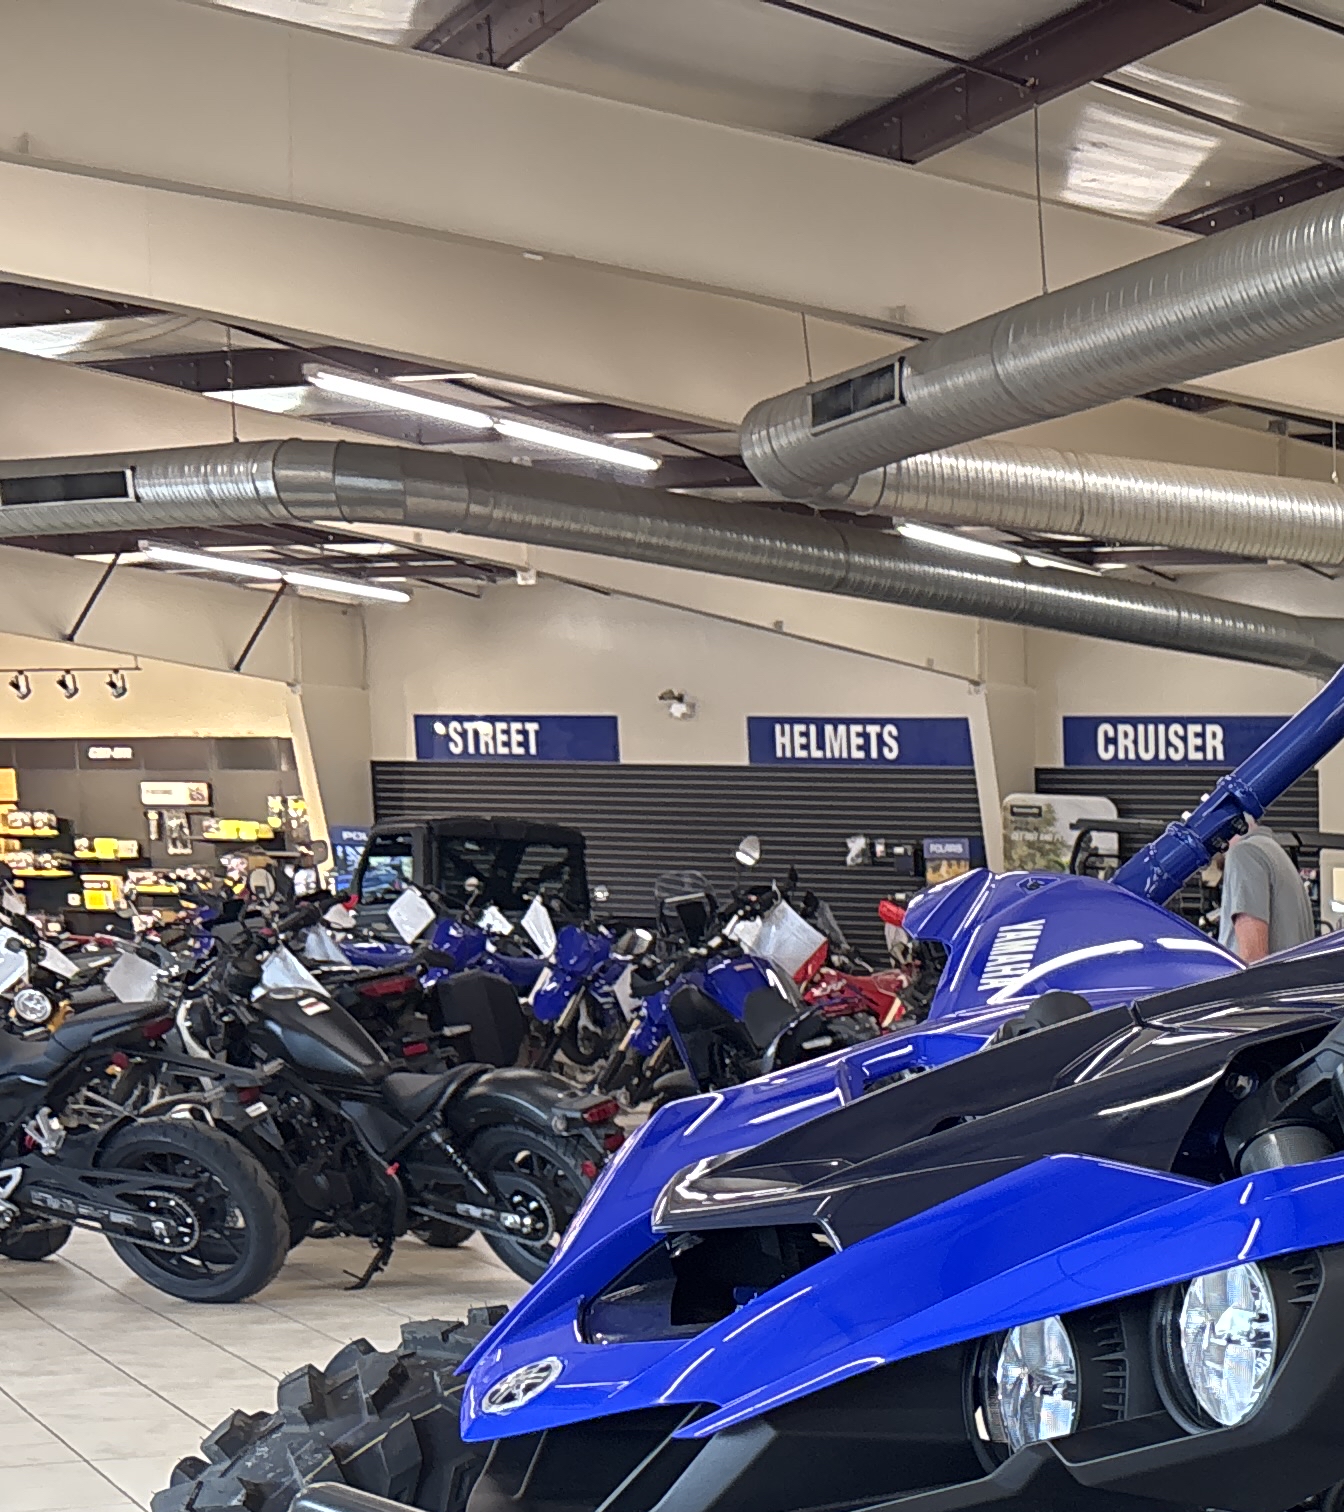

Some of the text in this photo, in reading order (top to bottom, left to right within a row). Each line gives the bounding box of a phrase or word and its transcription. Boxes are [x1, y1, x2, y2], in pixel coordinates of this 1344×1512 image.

[448, 720, 540, 755] STREET
[774, 722, 899, 760] HELMETS
[1097, 722, 1225, 762] CRUISER
[977, 918, 1046, 992] YAMAHA
